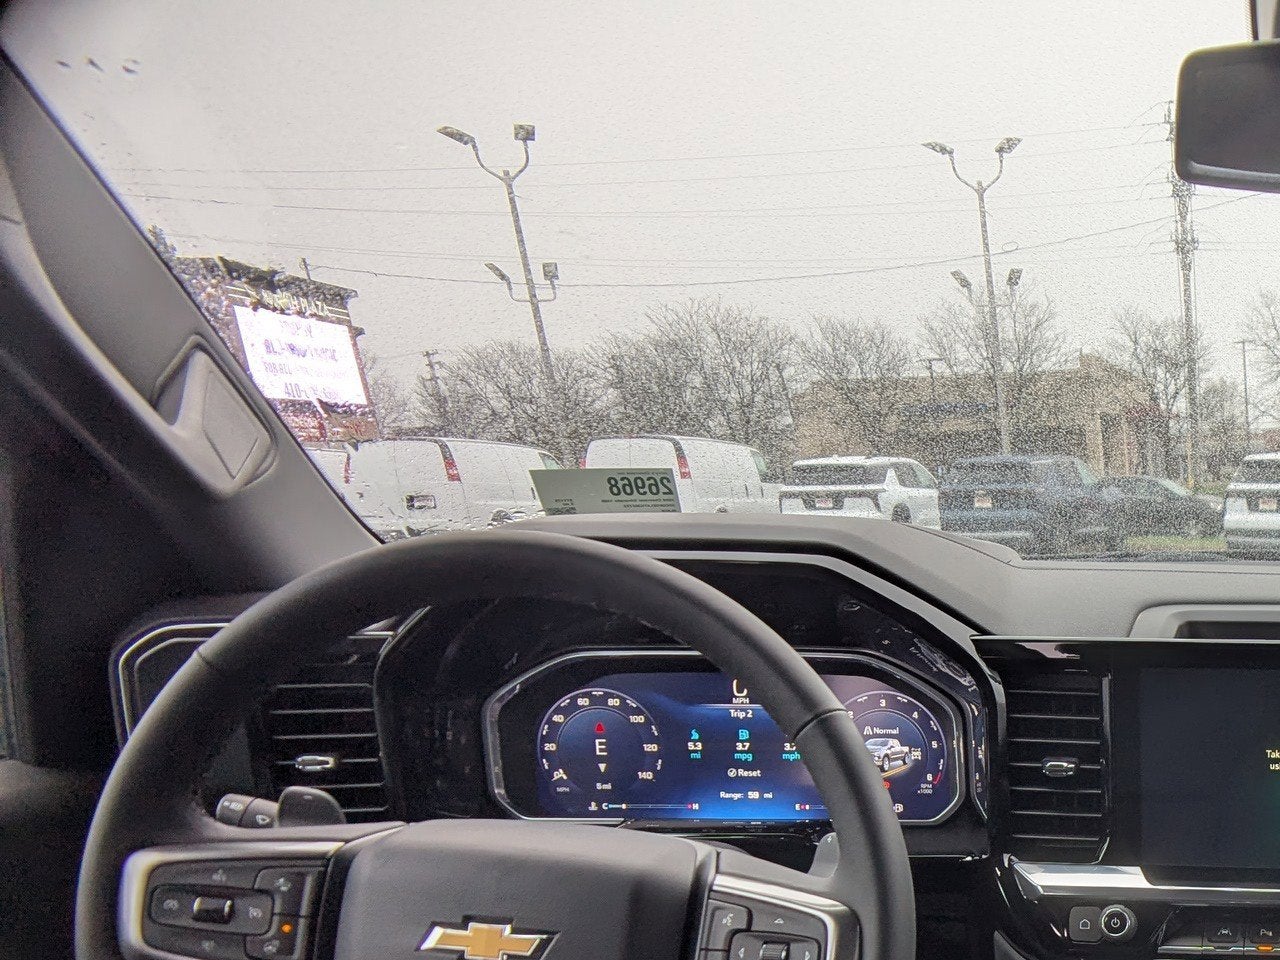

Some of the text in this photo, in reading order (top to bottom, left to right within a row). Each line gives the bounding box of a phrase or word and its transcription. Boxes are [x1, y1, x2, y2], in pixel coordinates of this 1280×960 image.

[577, 698, 590, 706] 60
[607, 698, 620, 706] 80
[729, 710, 753, 719] Trip 2
[912, 711, 919, 719] 4
[629, 715, 645, 723] 100
[595, 739, 608, 755] E
[687, 742, 702, 750] 5.3
[931, 740, 938, 748] 5
[734, 753, 753, 761] mpg
[782, 753, 801, 761] mph
[637, 771, 653, 779] 140
[737, 769, 761, 777] Reset
[720, 791, 744, 800] Range:
[602, 802, 609, 810] C
